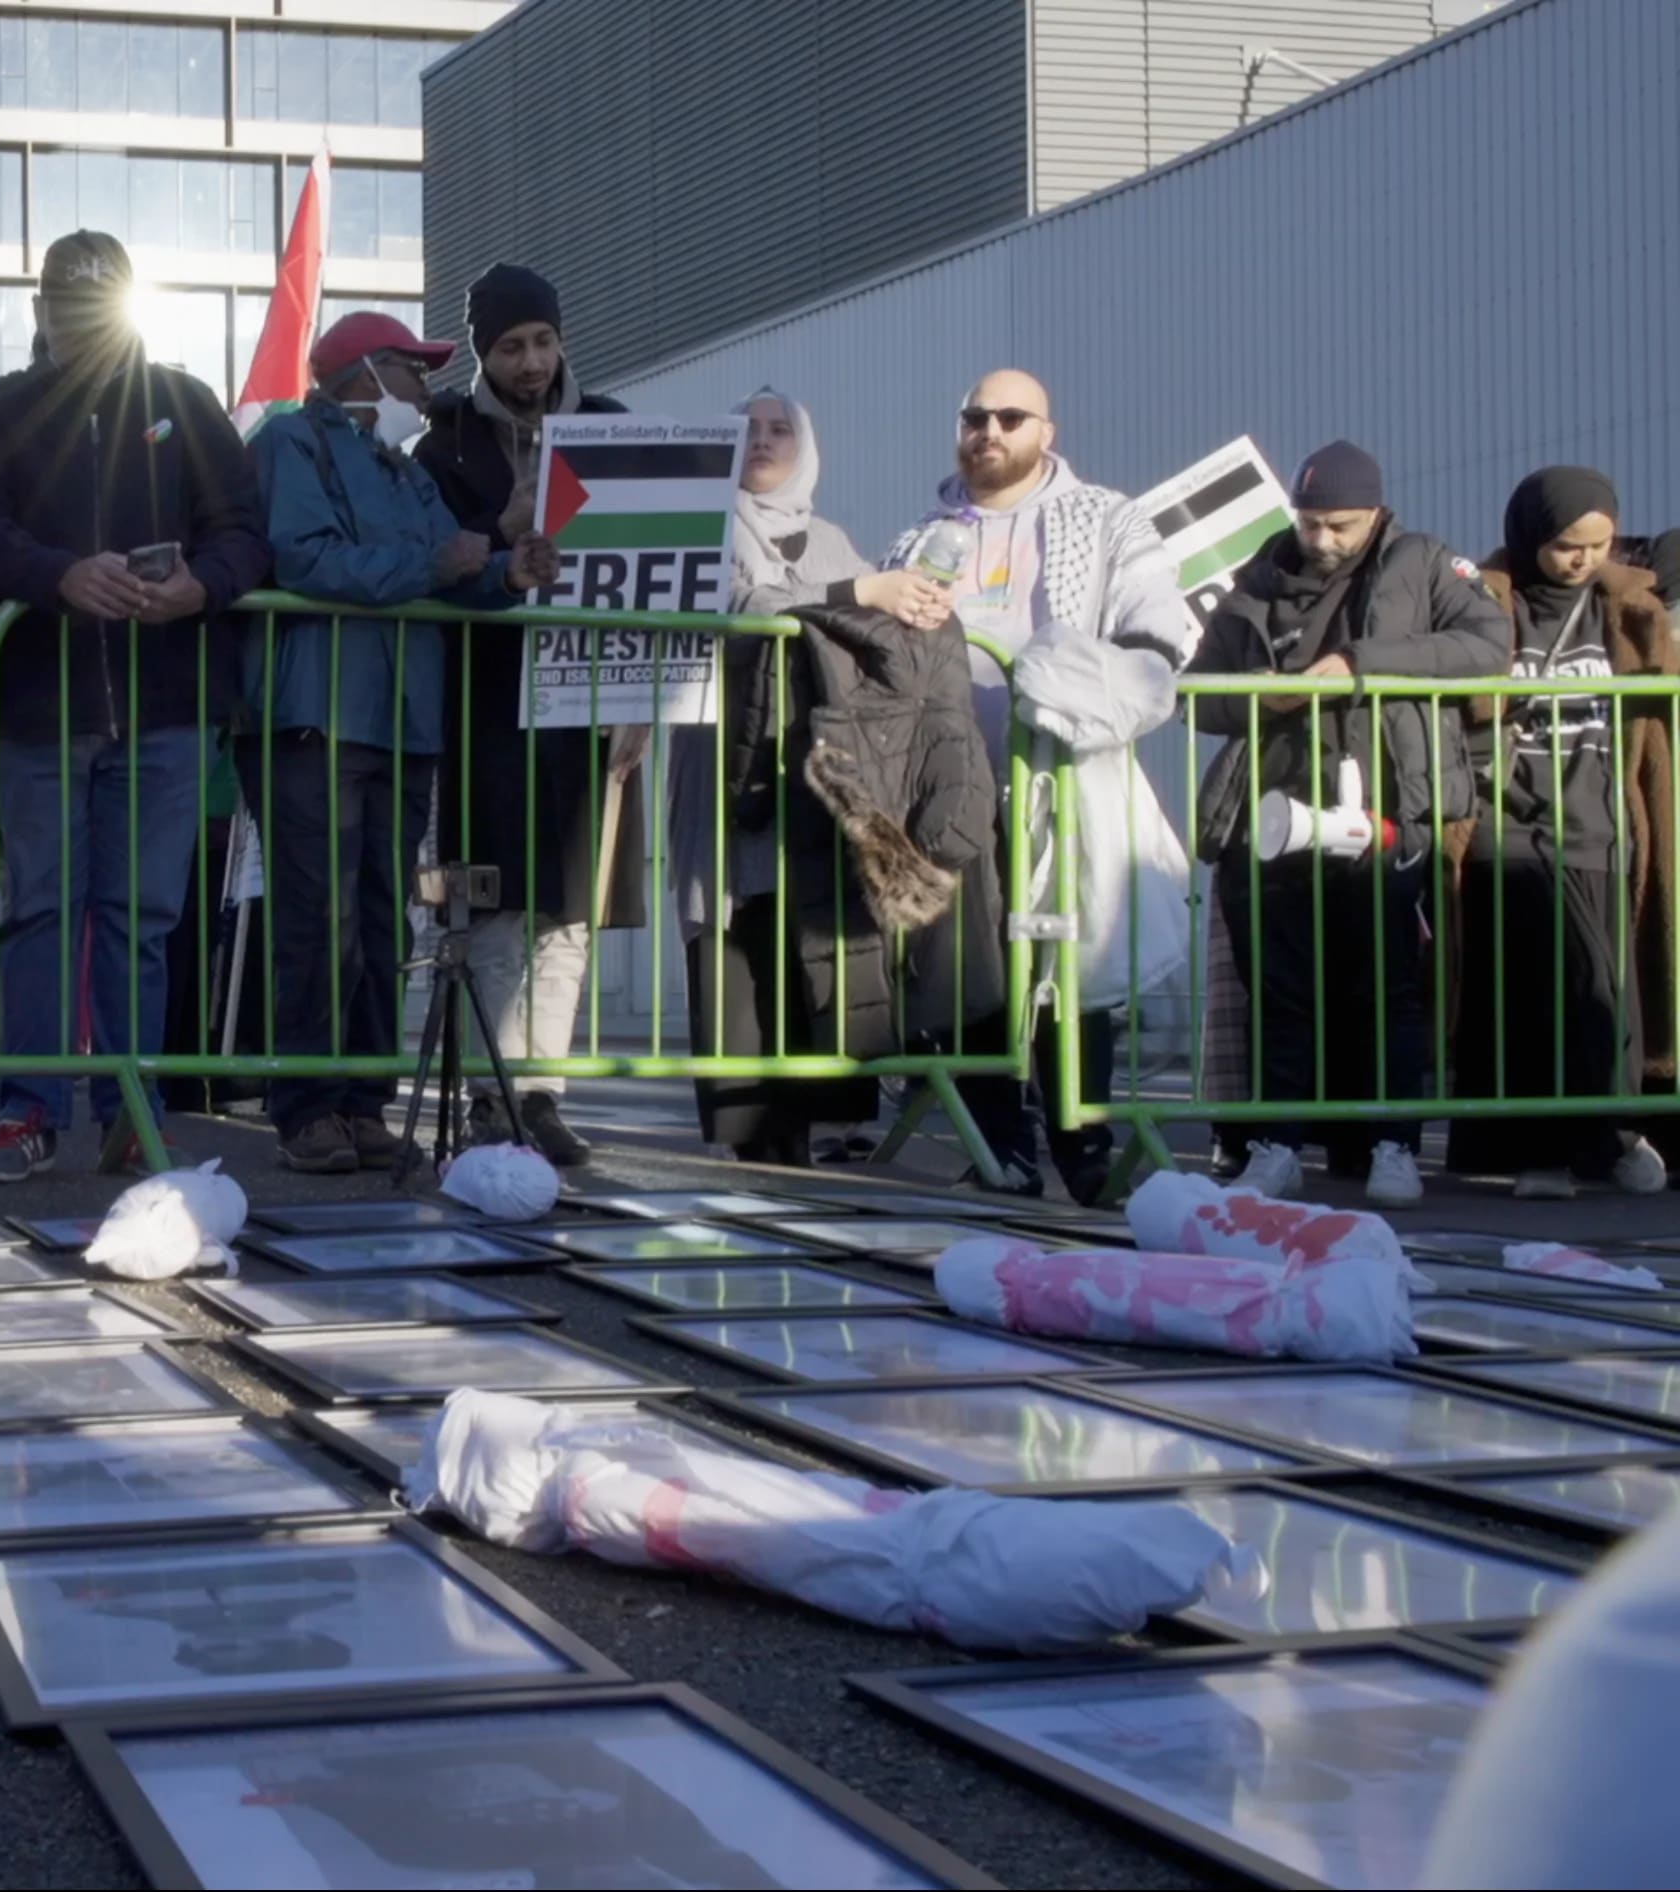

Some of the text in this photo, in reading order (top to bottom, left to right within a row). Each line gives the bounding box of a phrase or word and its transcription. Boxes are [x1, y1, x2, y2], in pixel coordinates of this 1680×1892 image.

[552, 424, 739, 442] Palestine Solidarity Campaign
[535, 551, 722, 614] FREE
[533, 626, 715, 662] PALESTINE
[533, 663, 712, 686] END ISRELI OCCPATIO
